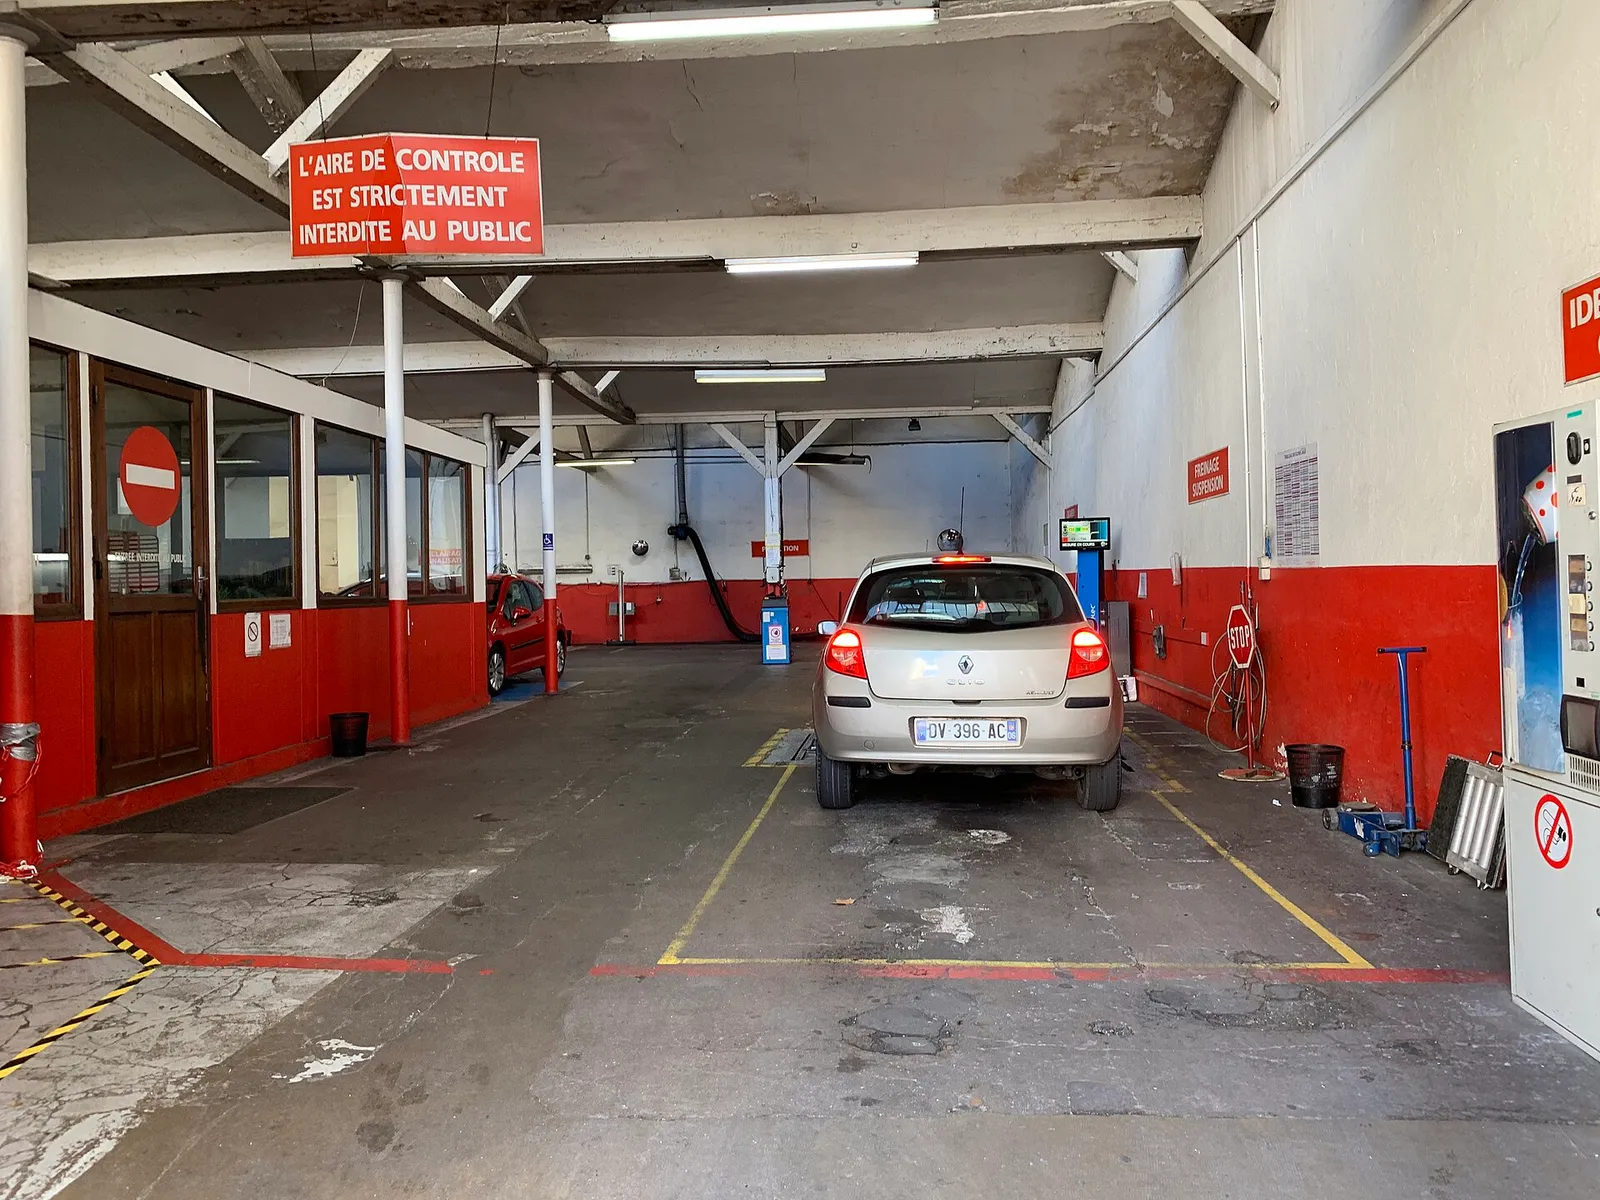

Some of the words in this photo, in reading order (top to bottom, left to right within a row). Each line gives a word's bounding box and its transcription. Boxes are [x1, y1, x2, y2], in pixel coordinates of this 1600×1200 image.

[299, 151, 353, 177] L'AIRE
[361, 148, 386, 172] DE
[395, 148, 525, 174] CONTROLE
[312, 187, 343, 210] EST
[350, 183, 508, 208] STRICTEMENT
[299, 220, 392, 245] INTERDITE
[401, 220, 436, 241] AU
[448, 220, 532, 242] PUBLIC
[1194, 456, 1220, 479] FREINAGE
[1192, 474, 1224, 497] SUSPENSION
[170, 553, 187, 563] PUBLIC
[1229, 624, 1250, 649] STOP
[946, 678, 986, 686] CLIO
